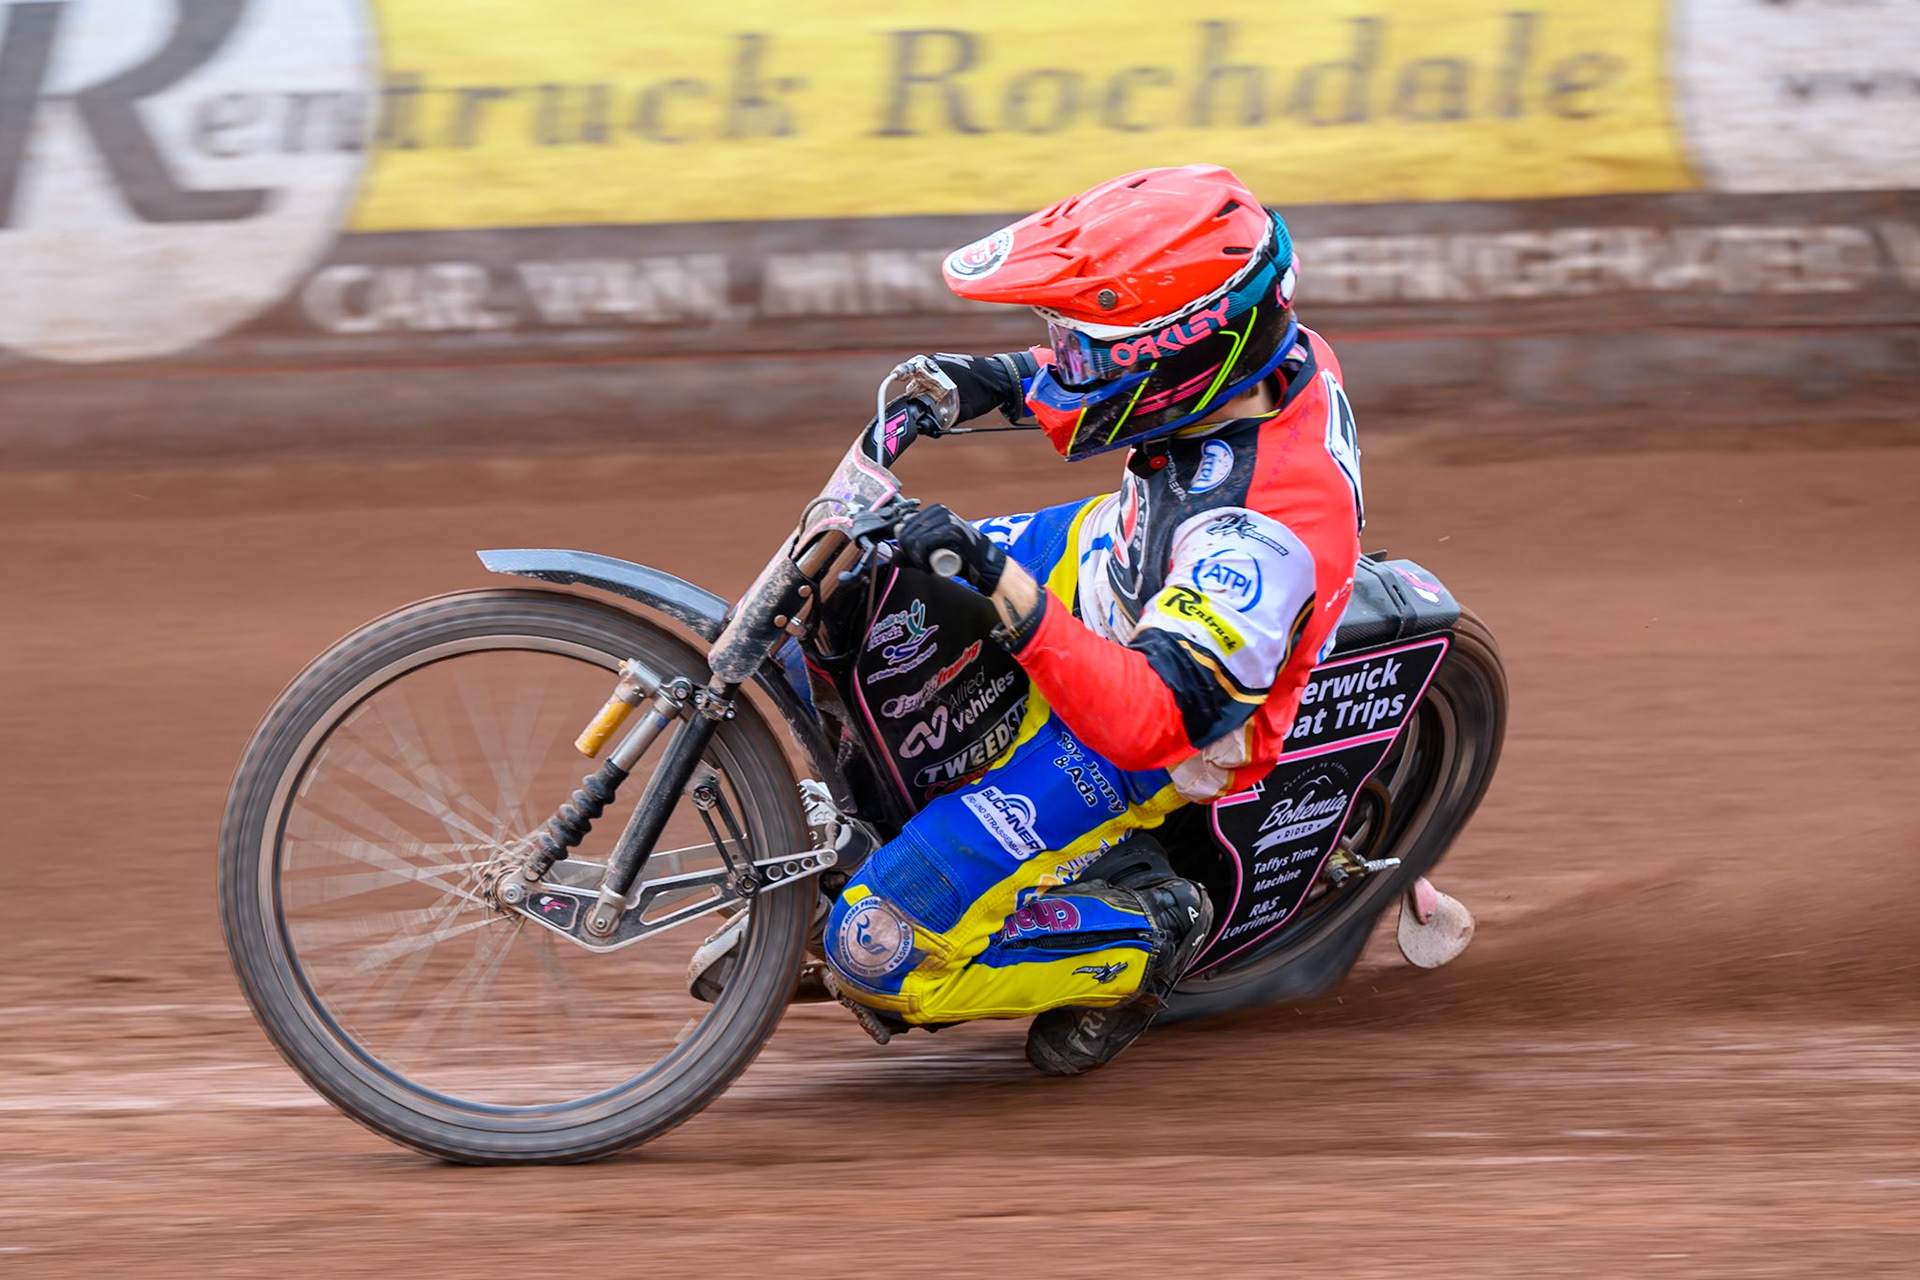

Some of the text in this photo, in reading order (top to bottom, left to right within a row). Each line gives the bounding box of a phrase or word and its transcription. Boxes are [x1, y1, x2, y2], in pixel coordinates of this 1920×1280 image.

[868, 10, 1626, 138] Rochdale
[1110, 297, 1230, 367] OAKLEY
[1203, 564, 1253, 597] ATPI
[1165, 588, 1238, 653] Rentruck
[951, 666, 985, 713] Allied
[1300, 658, 1402, 705] erwick
[1335, 694, 1406, 730] Trips
[1053, 756, 1099, 808] & Ada
[982, 789, 1042, 850] BUCHNER
[1258, 789, 1348, 832] Bohemia
[1284, 824, 1313, 839] RIDER
[984, 812, 1024, 856] STRASSENBAU
[1253, 847, 1319, 875] Taffys Time
[1253, 868, 1302, 893] Machine
[1221, 908, 1288, 941] Lorriman
[1249, 896, 1281, 918] R&S
